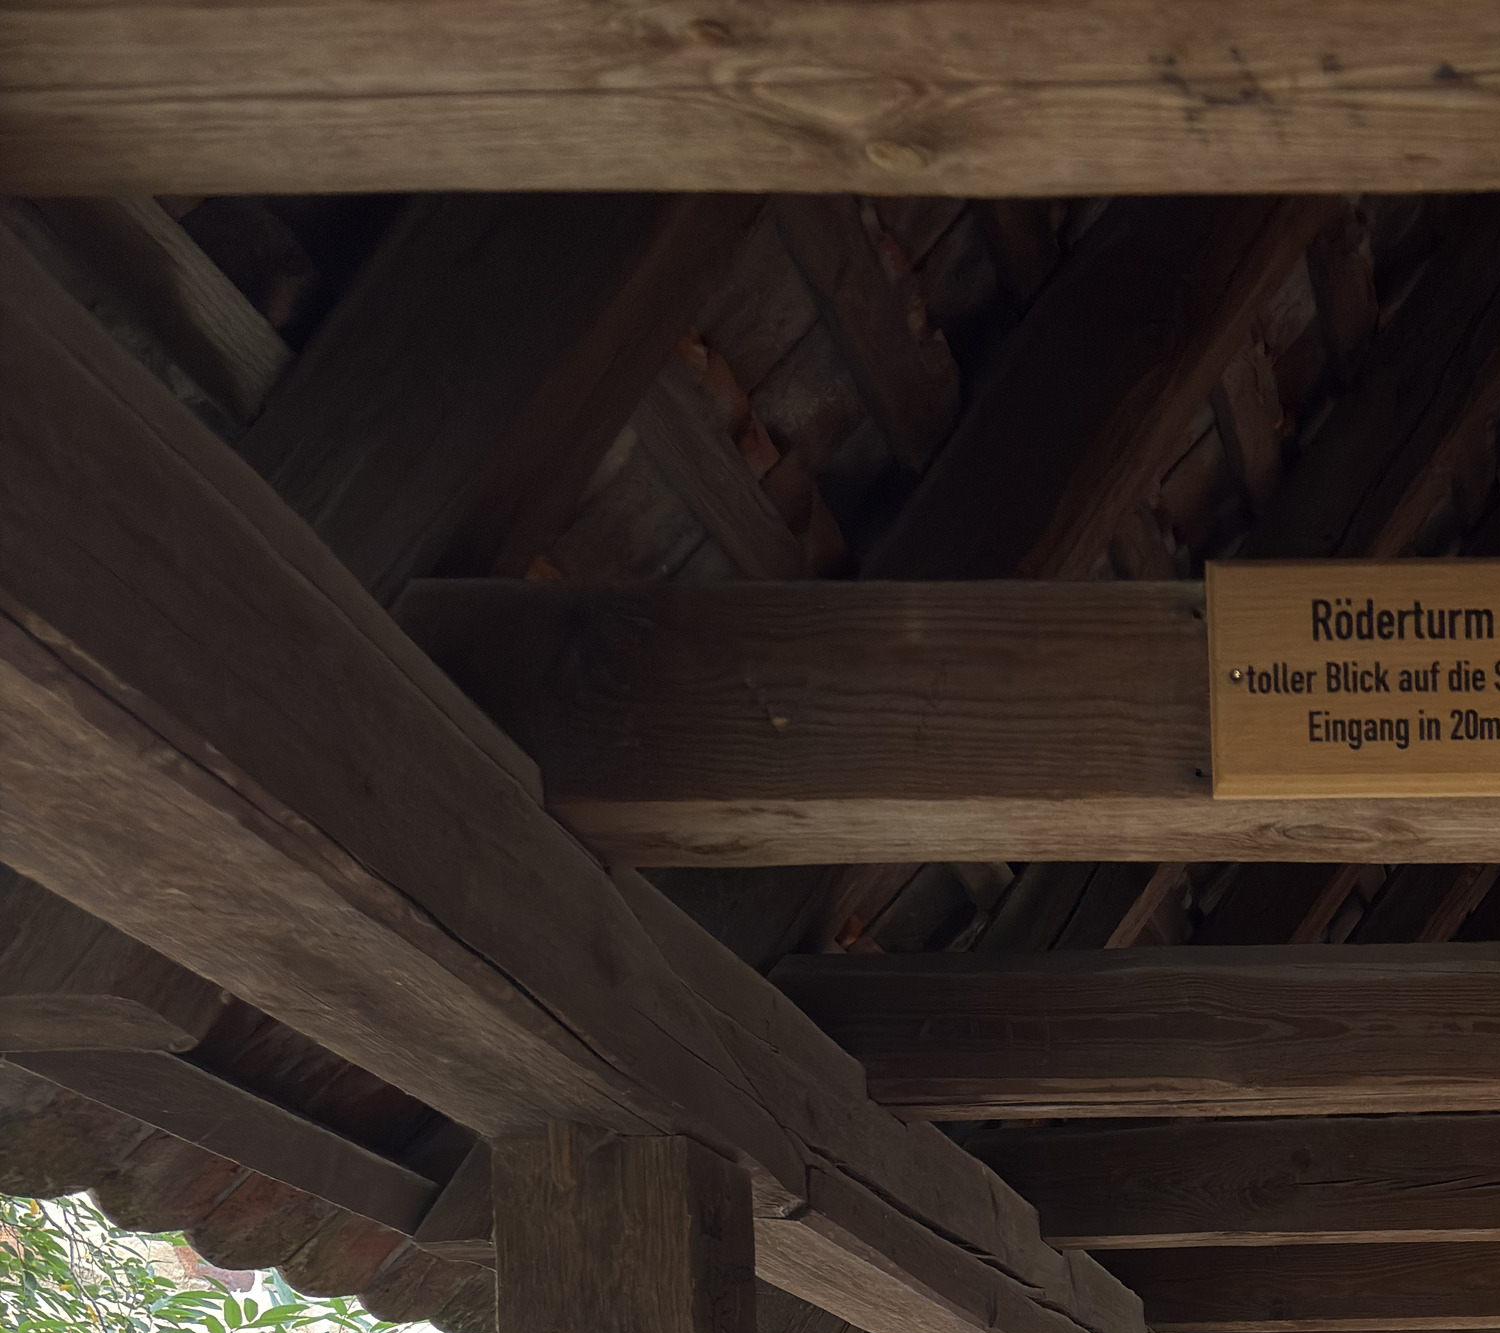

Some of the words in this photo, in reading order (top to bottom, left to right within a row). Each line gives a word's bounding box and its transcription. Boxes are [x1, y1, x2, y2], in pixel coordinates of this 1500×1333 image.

[1311, 597, 1494, 642] Röderturm
[1246, 662, 1318, 695] toller
[1325, 661, 1391, 694] Blick
[1398, 660, 1441, 693] auf
[1448, 659, 1486, 693] die
[1308, 710, 1410, 751] Eingang
[1418, 708, 1441, 741] in
